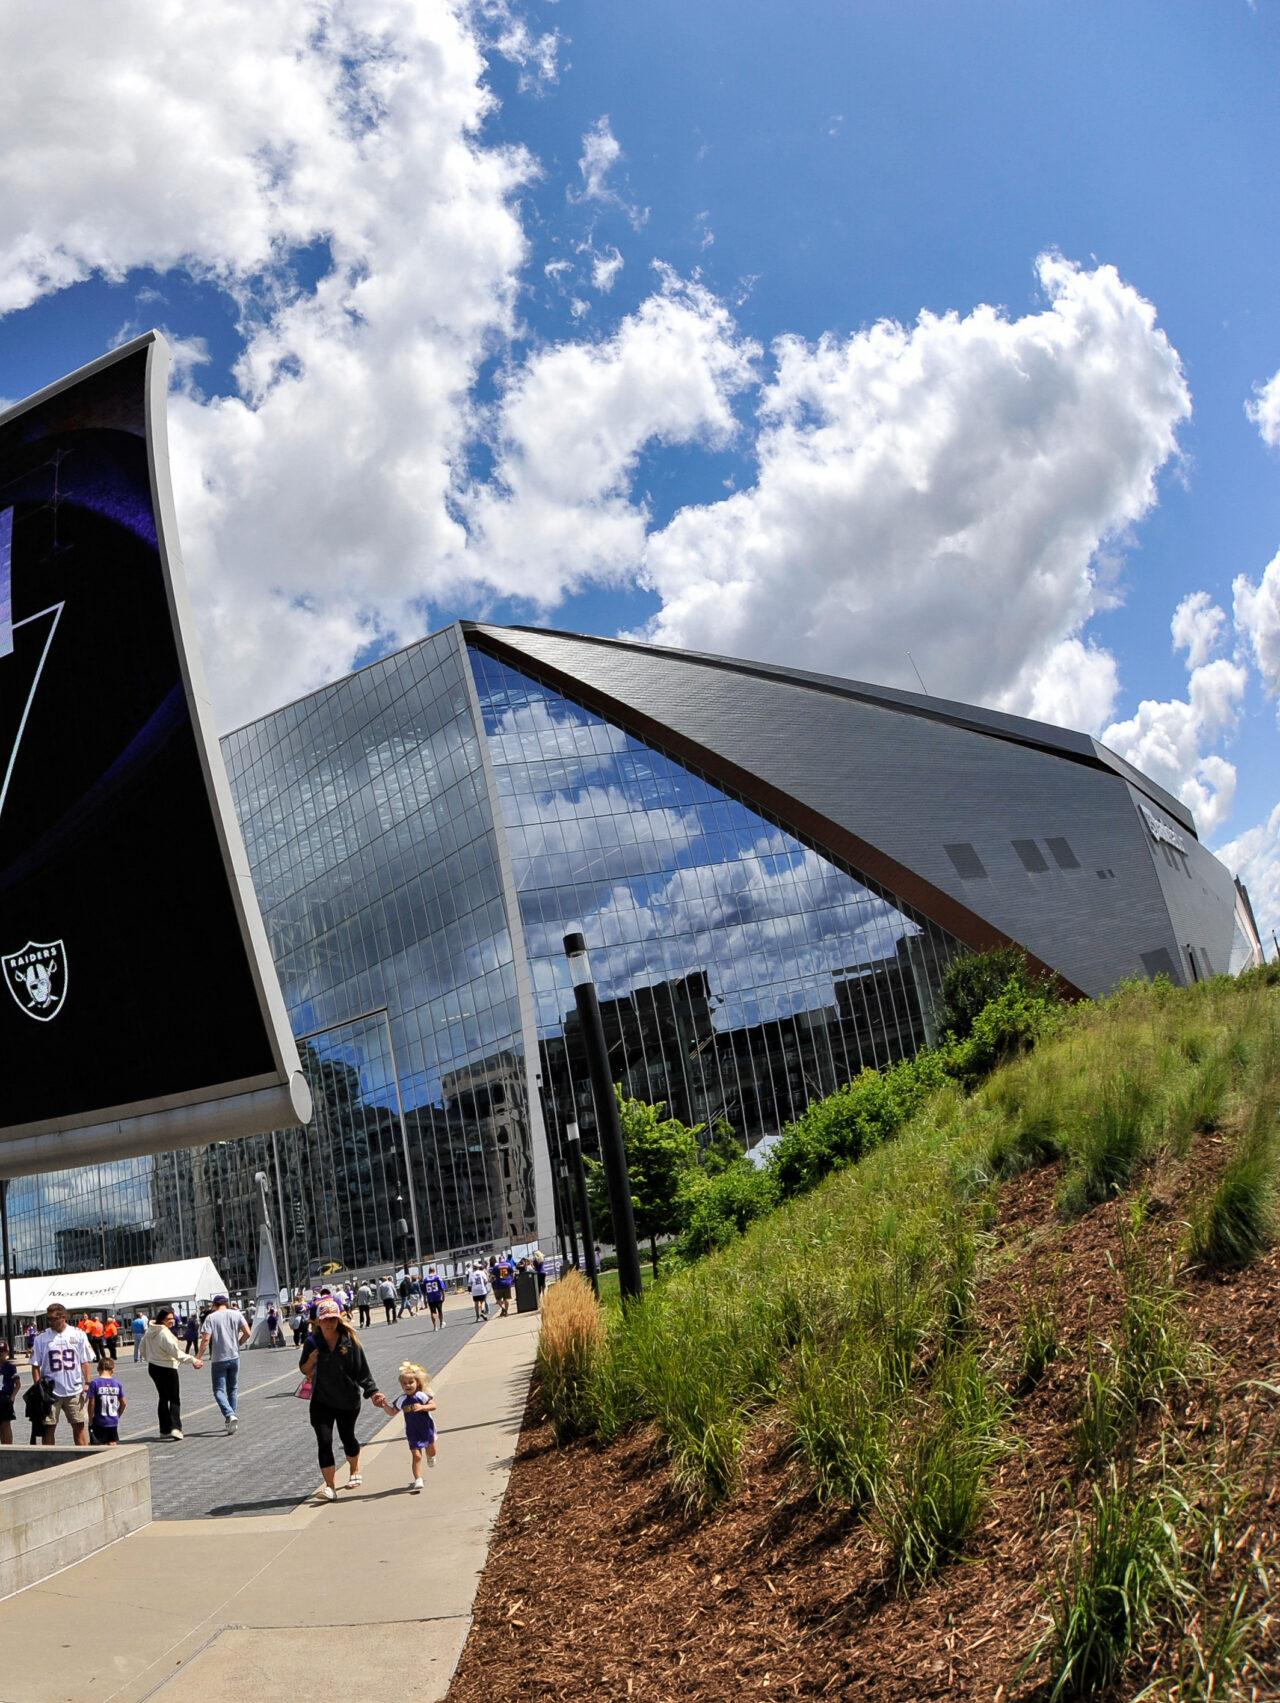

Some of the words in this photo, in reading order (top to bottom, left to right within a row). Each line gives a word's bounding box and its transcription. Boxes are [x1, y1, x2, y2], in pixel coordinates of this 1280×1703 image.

[10, 946, 57, 968] RAIDERS
[48, 1284, 119, 1298] Medtronic
[425, 1281, 439, 1293] 69
[48, 1348, 76, 1373] 69
